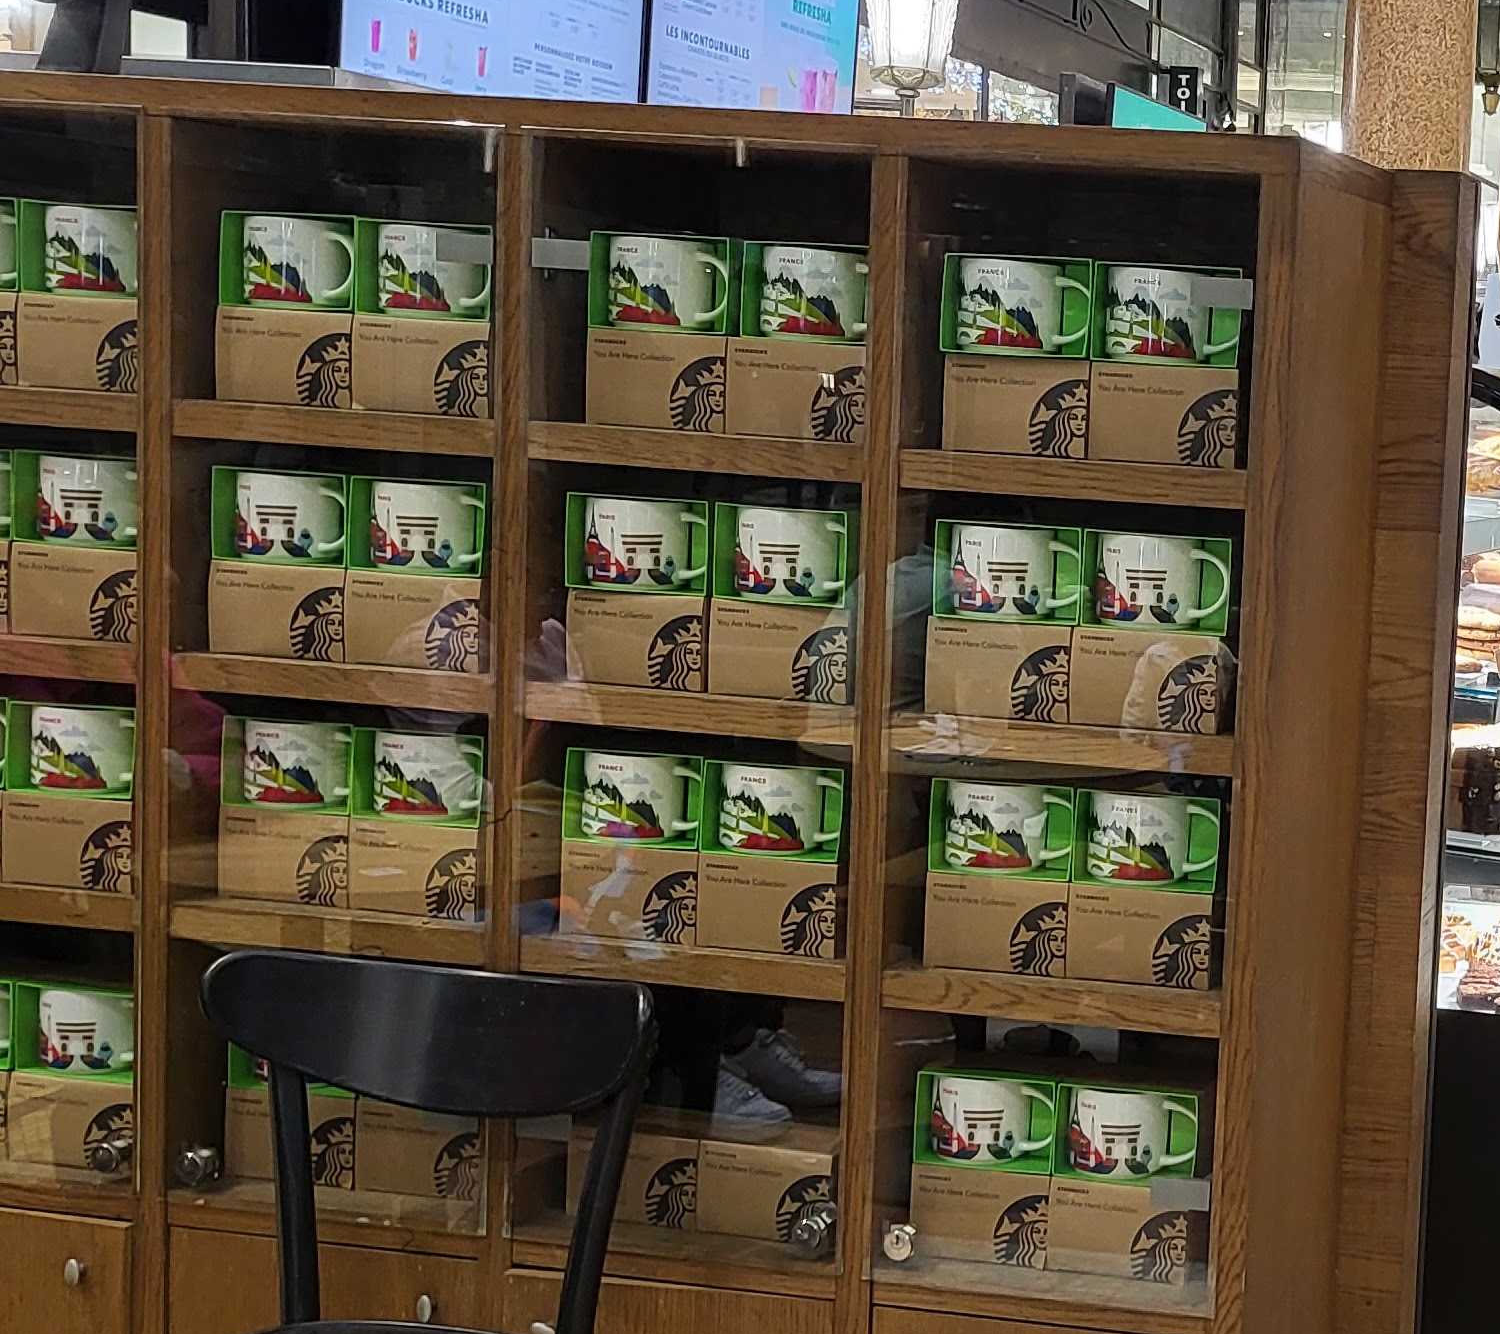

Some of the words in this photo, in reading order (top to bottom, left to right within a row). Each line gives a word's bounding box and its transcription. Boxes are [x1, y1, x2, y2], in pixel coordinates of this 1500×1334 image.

[438, 0, 488, 24] REFRESHA
[793, 0, 831, 25] REFRESHA
[666, 25, 678, 38] LES
[681, 29, 749, 59] INCONTOURNABLES
[598, 764, 623, 772] FRANCE
[740, 776, 766, 784] FRANCE
[968, 793, 994, 802] FRANCE
